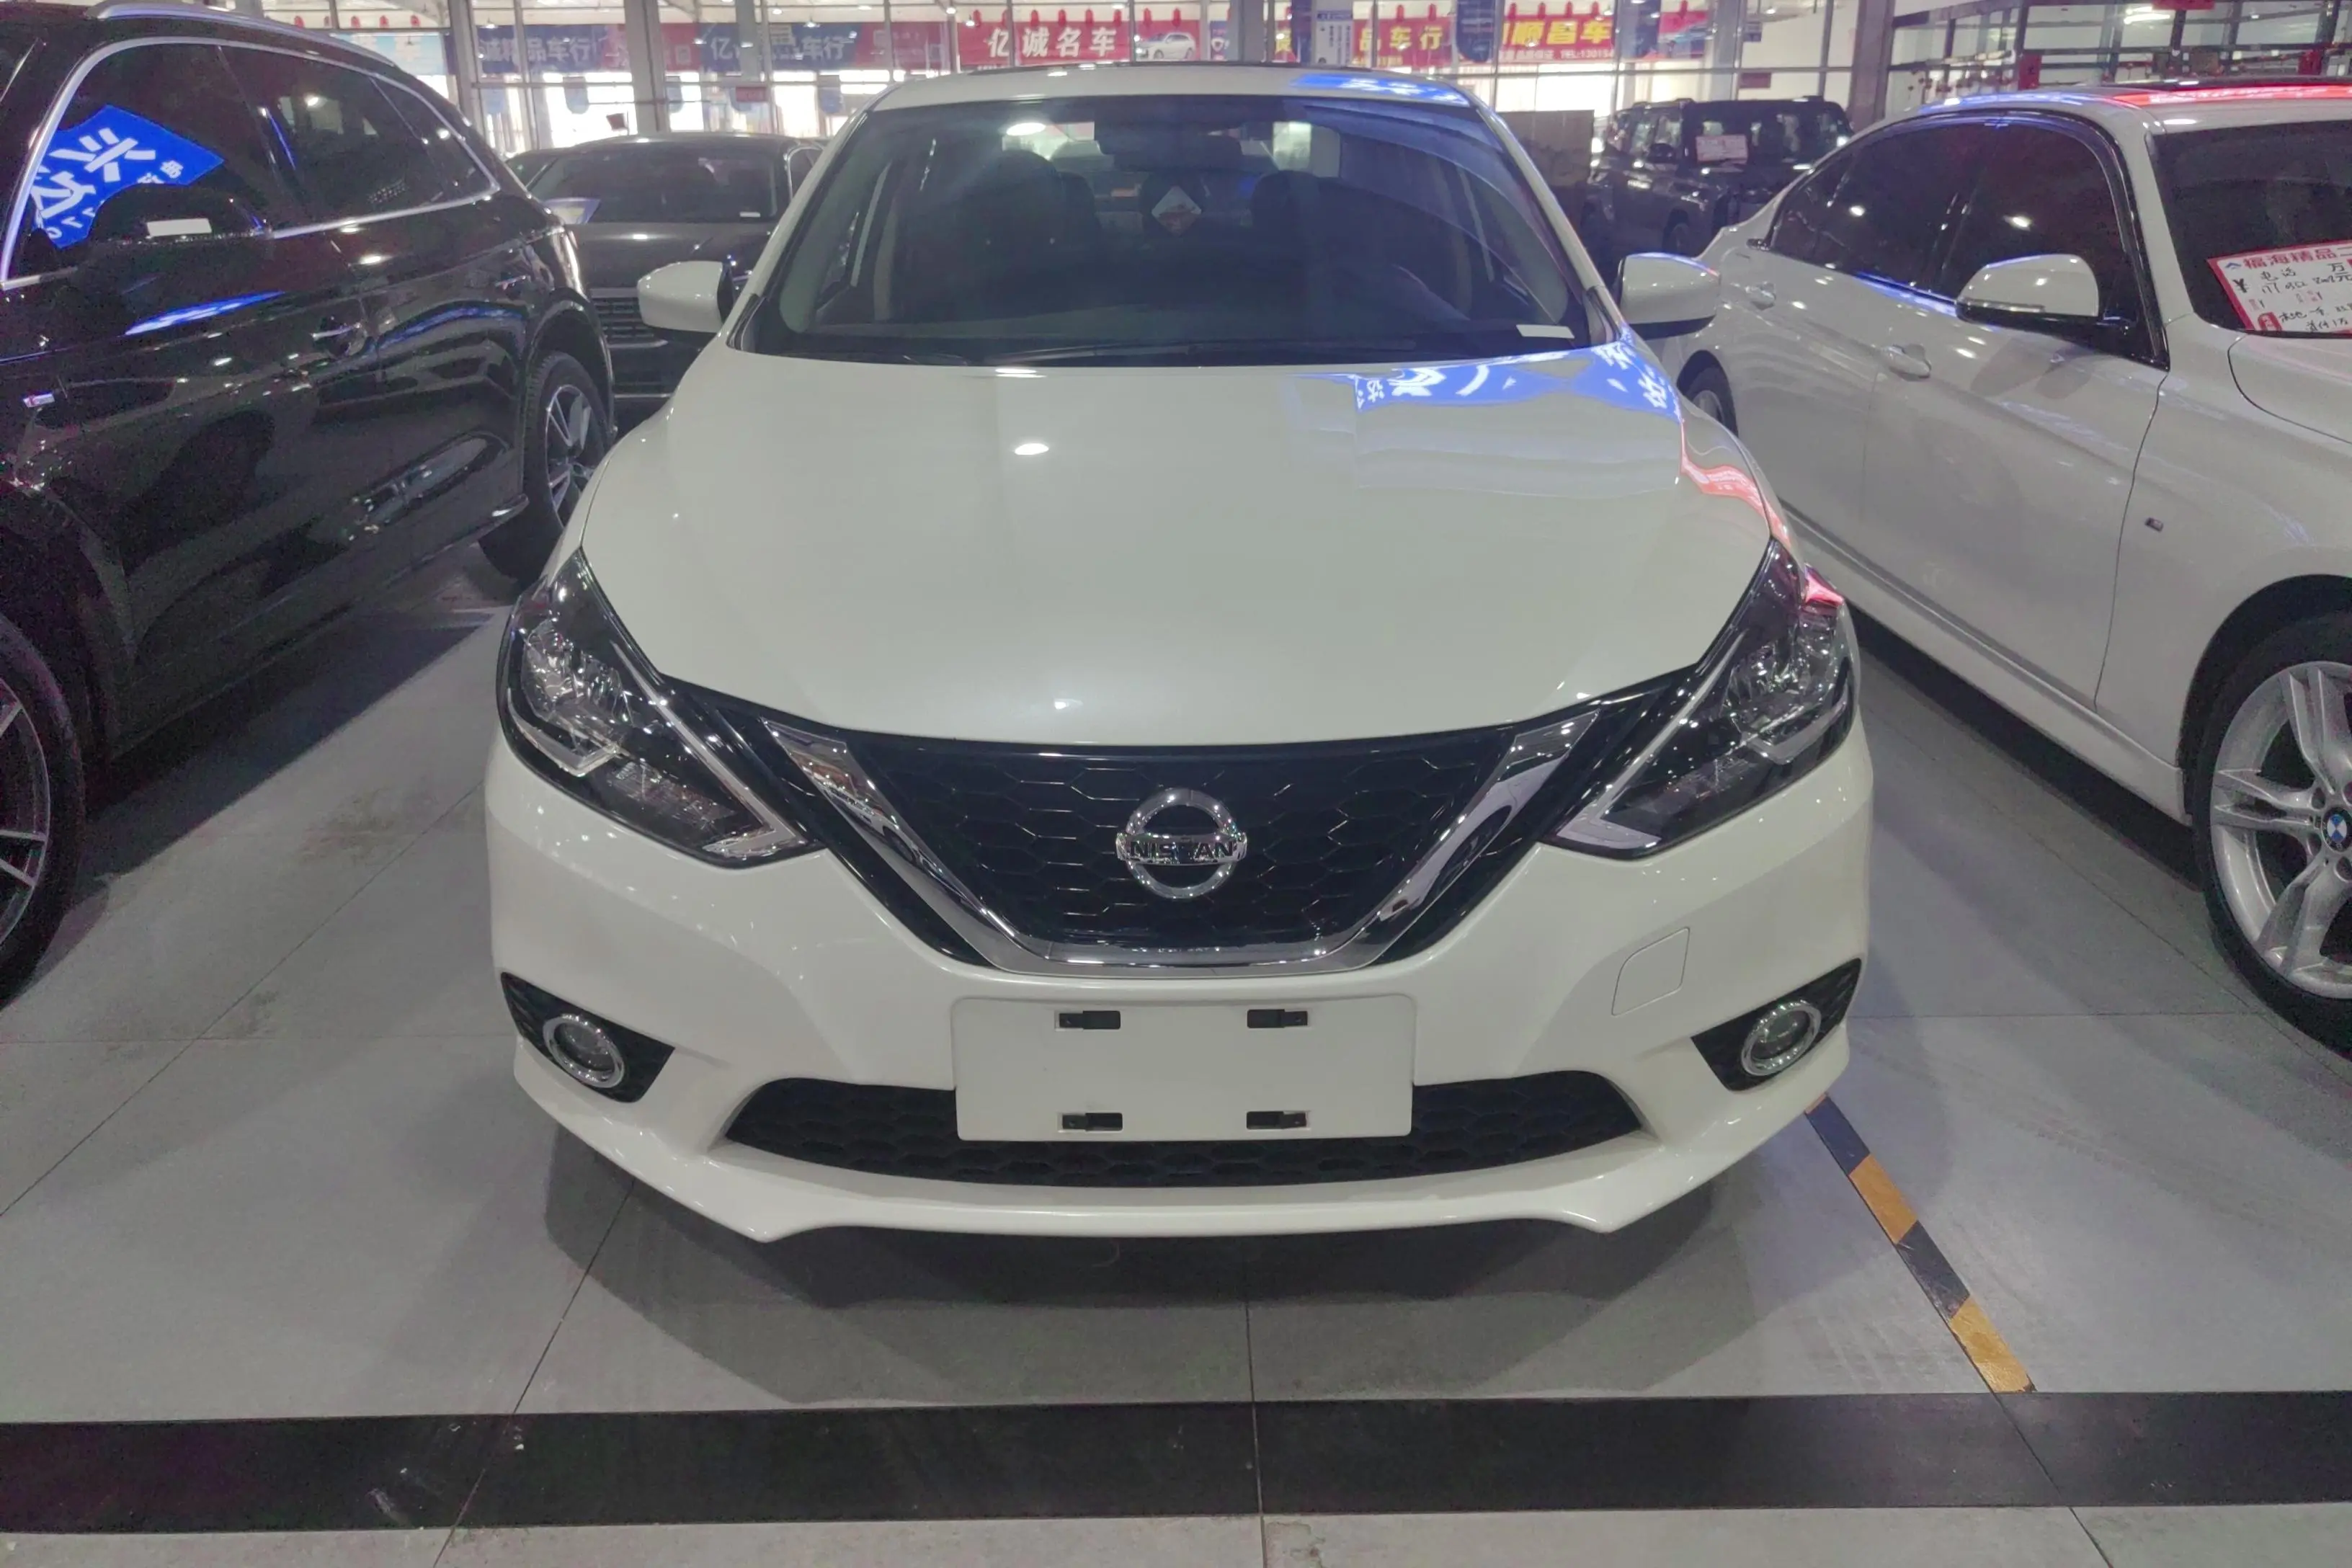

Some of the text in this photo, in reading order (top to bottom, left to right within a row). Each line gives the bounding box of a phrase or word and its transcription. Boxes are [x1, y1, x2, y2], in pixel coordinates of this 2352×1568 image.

[988, 27, 1116, 58] 亿诚名车
[1503, 20, 1613, 45] 顺昌车
